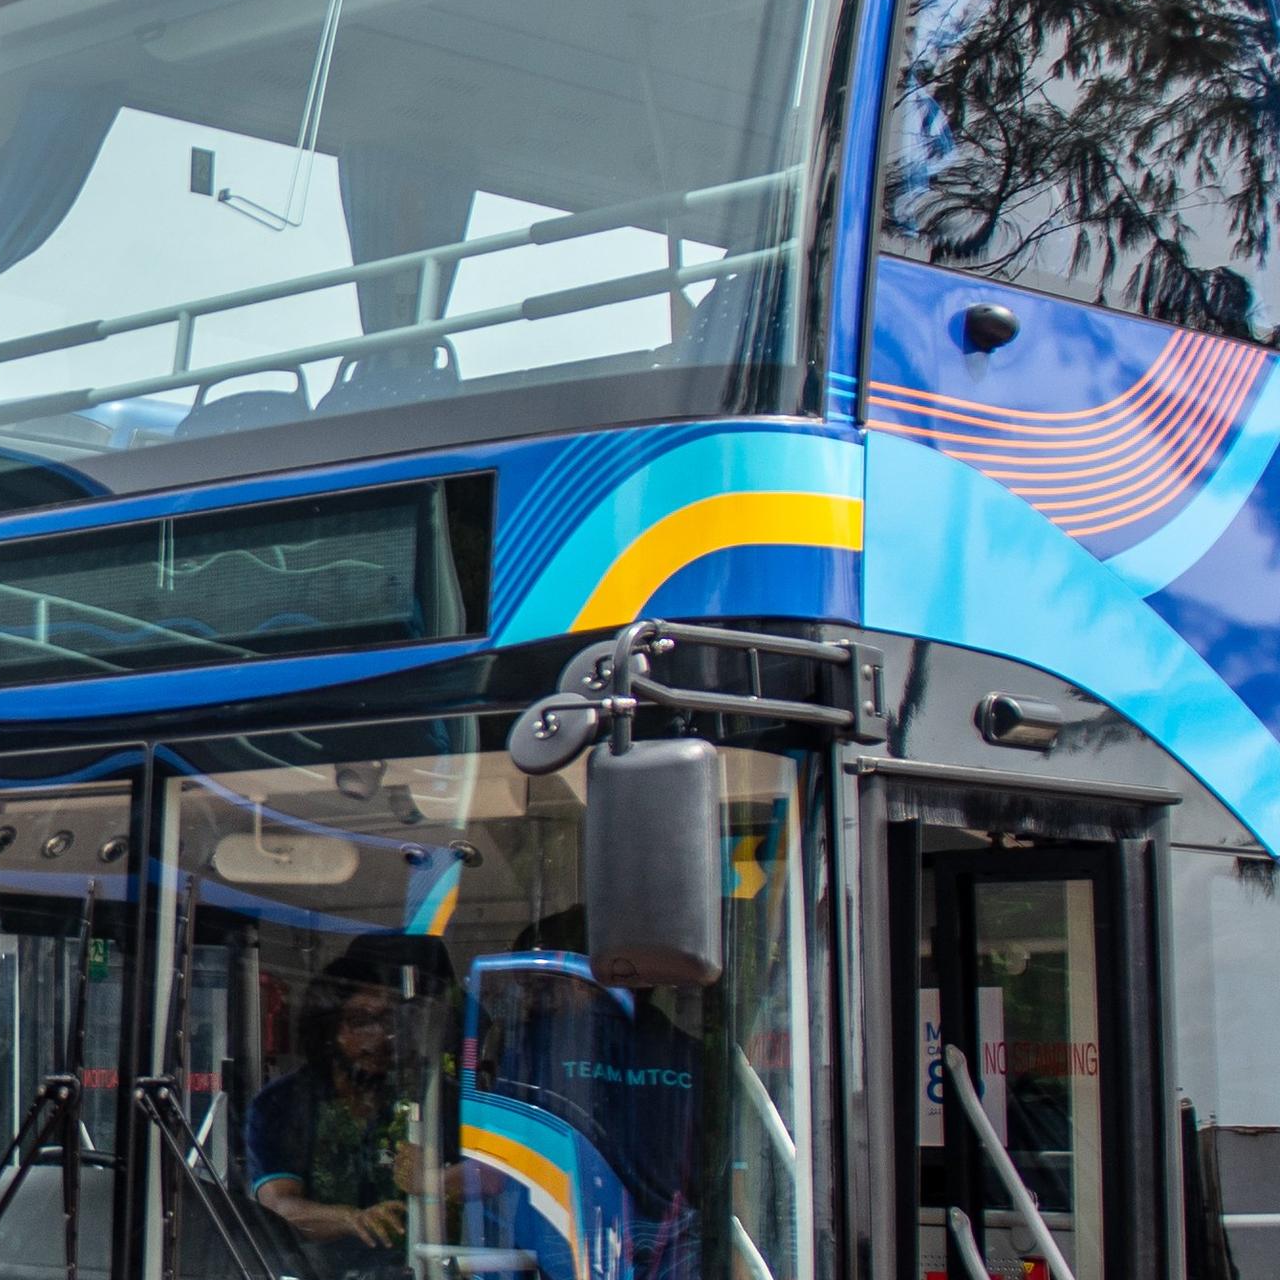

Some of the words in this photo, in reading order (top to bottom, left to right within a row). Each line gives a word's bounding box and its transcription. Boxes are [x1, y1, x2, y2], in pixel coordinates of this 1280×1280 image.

[983, 1041, 1009, 1075] NO
[563, 1060, 622, 1082] TEAM
[626, 1068, 693, 1089] MTCC
